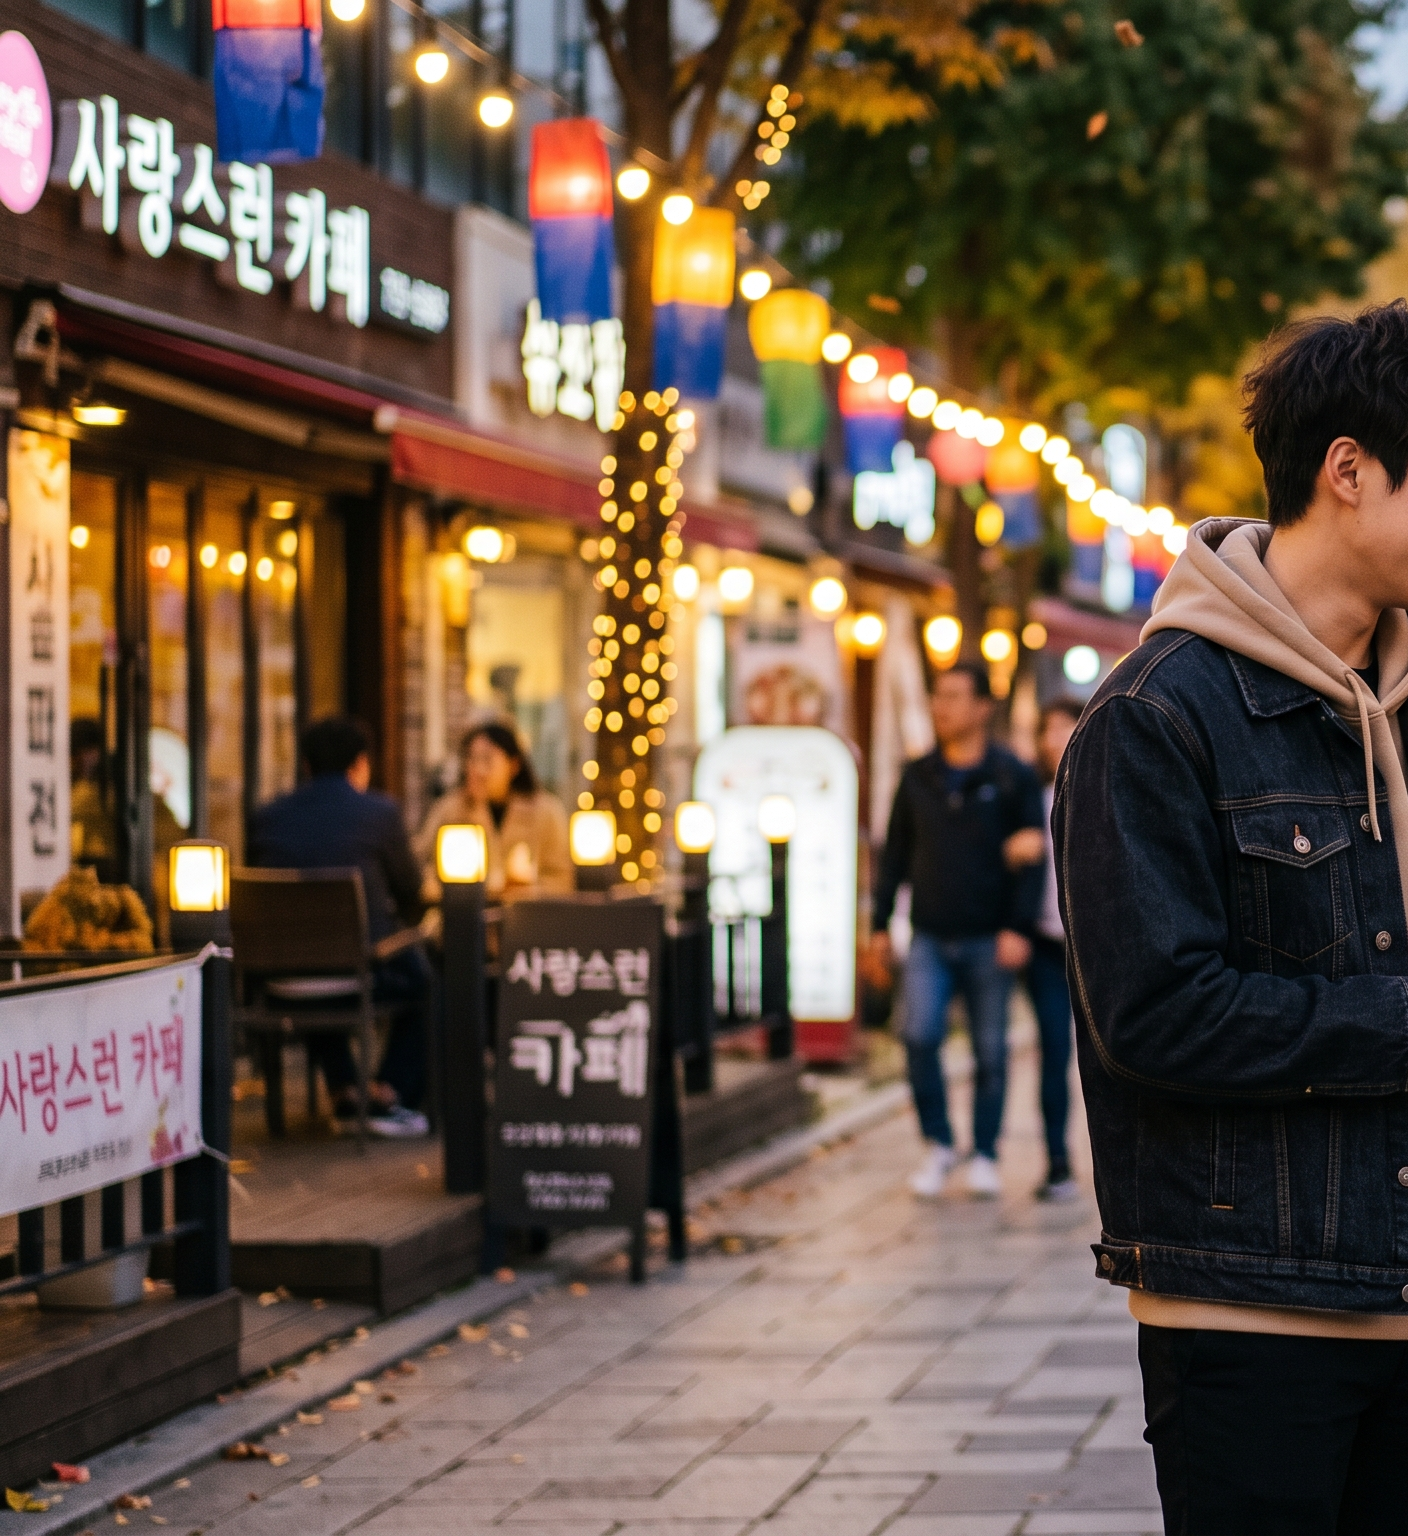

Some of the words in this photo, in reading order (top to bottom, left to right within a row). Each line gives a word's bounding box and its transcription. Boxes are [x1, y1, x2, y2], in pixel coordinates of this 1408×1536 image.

[69, 94, 273, 295] 사랑스런
[284, 187, 370, 328] 카페
[506, 947, 650, 997] 사랑스런
[0, 1028, 124, 1135] 사랑스런
[130, 1013, 184, 1099] 카페
